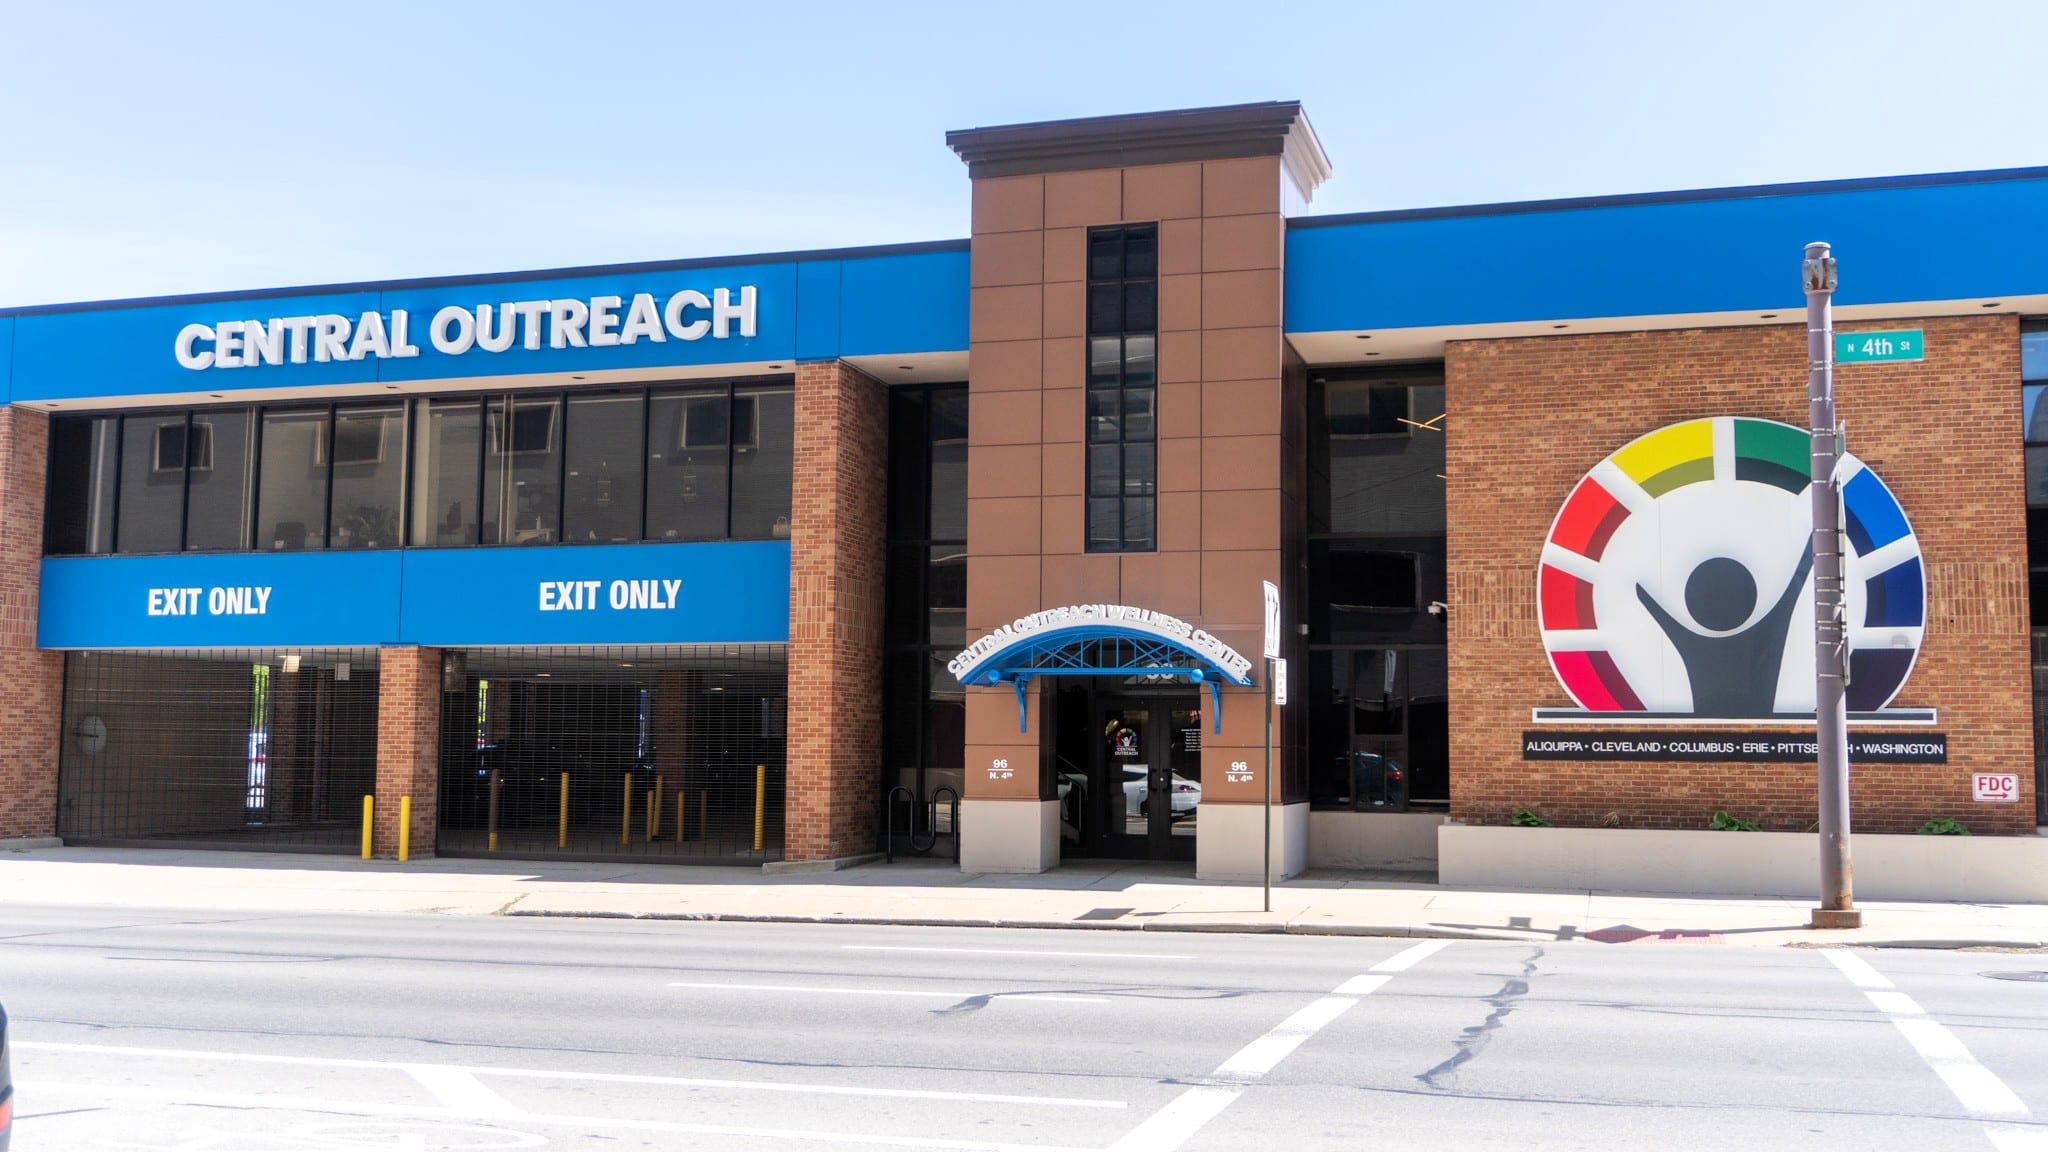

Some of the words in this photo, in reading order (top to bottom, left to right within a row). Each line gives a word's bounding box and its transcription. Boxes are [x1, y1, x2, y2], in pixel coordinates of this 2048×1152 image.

[174, 309, 419, 371] CENTRAL
[430, 286, 757, 355] OUTREACH
[1847, 343, 1854, 353] N
[1861, 338, 1893, 356] 4th
[1900, 340, 1910, 351] St
[148, 588, 203, 616] EXIT
[208, 586, 272, 615] ONLY
[539, 581, 601, 611] EXIT
[609, 579, 682, 610] ONLY
[947, 624, 1016, 674] CENTRAL
[1013, 604, 1106, 632] OUTREACH
[1107, 604, 1194, 638] WELLNESS
[1192, 629, 1252, 675] CENTER
[1526, 741, 1583, 752] ALIQUIPPA
[1591, 742, 1661, 752] CLEVELAND
[1669, 743, 1735, 753] COLUMBUS
[1743, 743, 1769, 753] ERIE
[1777, 743, 1853, 754] PITTSBH
[1862, 744, 1944, 754] WASHINGTON
[993, 759, 1008, 769] 96
[1231, 761, 1247, 771] 96
[989, 771, 999, 780] N.
[1227, 774, 1239, 783] N.
[1978, 776, 2012, 791] FDC
